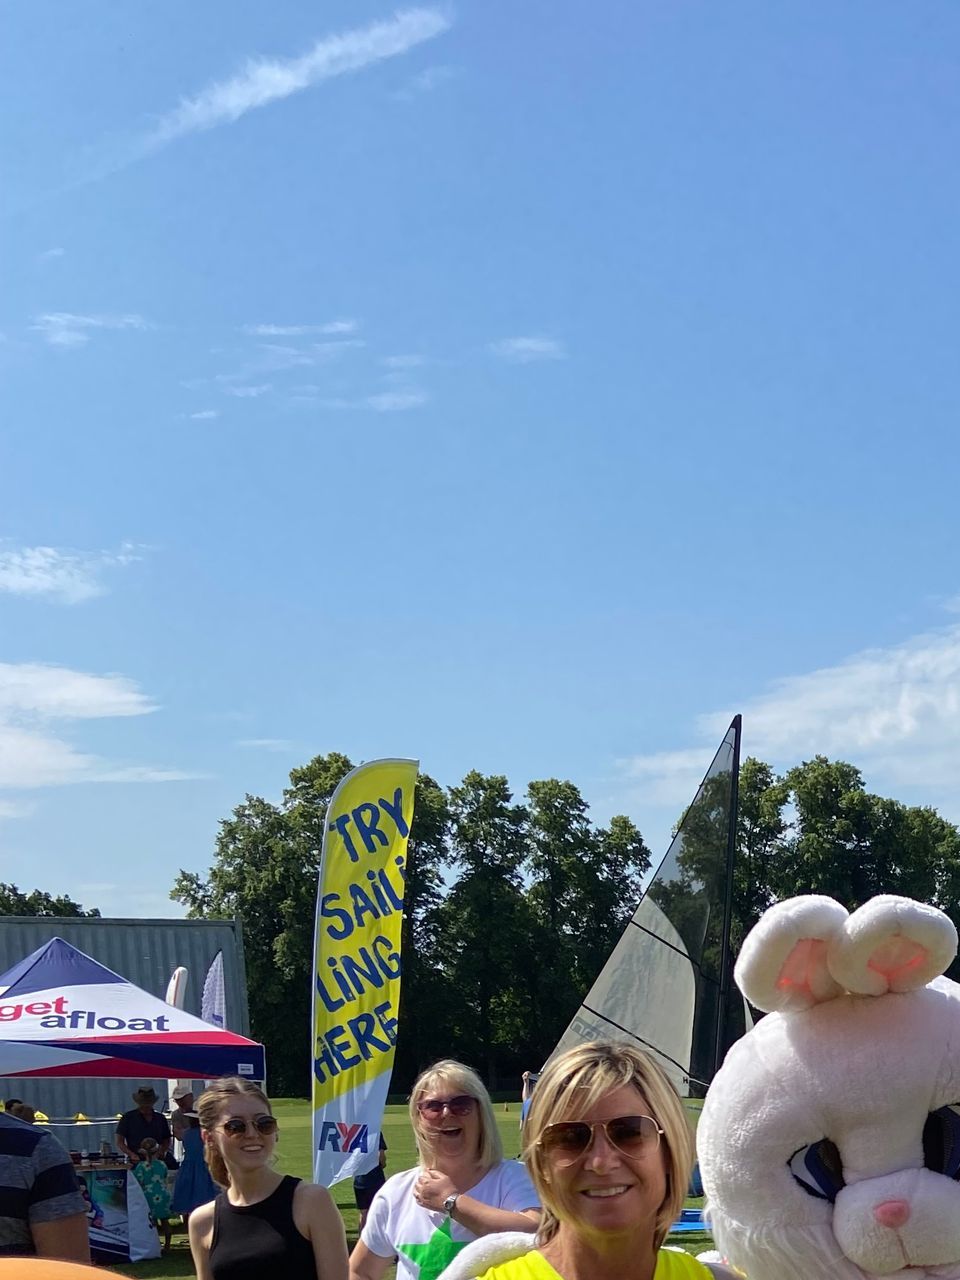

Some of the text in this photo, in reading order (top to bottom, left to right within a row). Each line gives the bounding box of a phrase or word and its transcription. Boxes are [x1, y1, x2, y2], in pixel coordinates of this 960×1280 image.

[329, 787, 409, 862] TRY
[0, 996, 68, 1021] get
[40, 1010, 170, 1031] afloat
[314, 1001, 398, 1084] HERE
[319, 1121, 368, 1153] RYA
